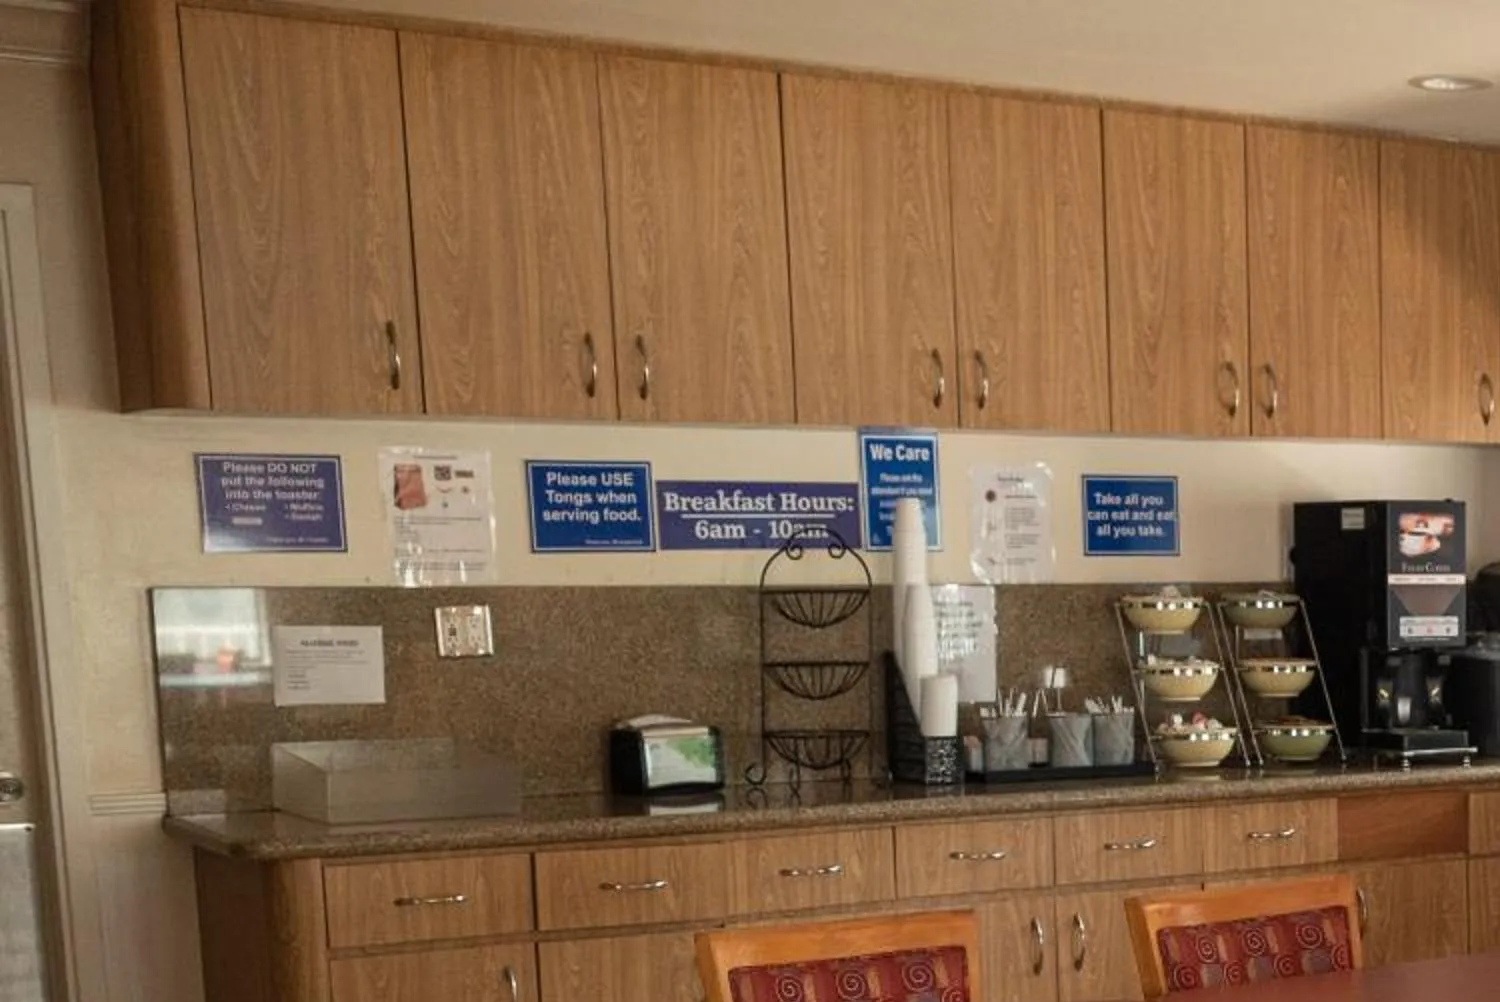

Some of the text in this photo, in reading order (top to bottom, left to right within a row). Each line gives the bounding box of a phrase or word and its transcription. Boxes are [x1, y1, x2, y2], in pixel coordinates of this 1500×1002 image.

[869, 444, 931, 461] We Care
[223, 461, 317, 473] Please DO NOT
[222, 476, 325, 489] put the following
[546, 471, 634, 486] Please USE
[545, 490, 637, 507] Tongs when
[663, 490, 856, 511] Breakfast Hours:
[1094, 492, 1164, 508] Take all you
[543, 508, 641, 524] serving food.
[1088, 511, 1109, 520] can
[1111, 510, 1129, 520] eat
[1131, 510, 1154, 520] and
[695, 520, 746, 539] 6am
[1097, 524, 1111, 536] all
[1113, 527, 1136, 539] you
